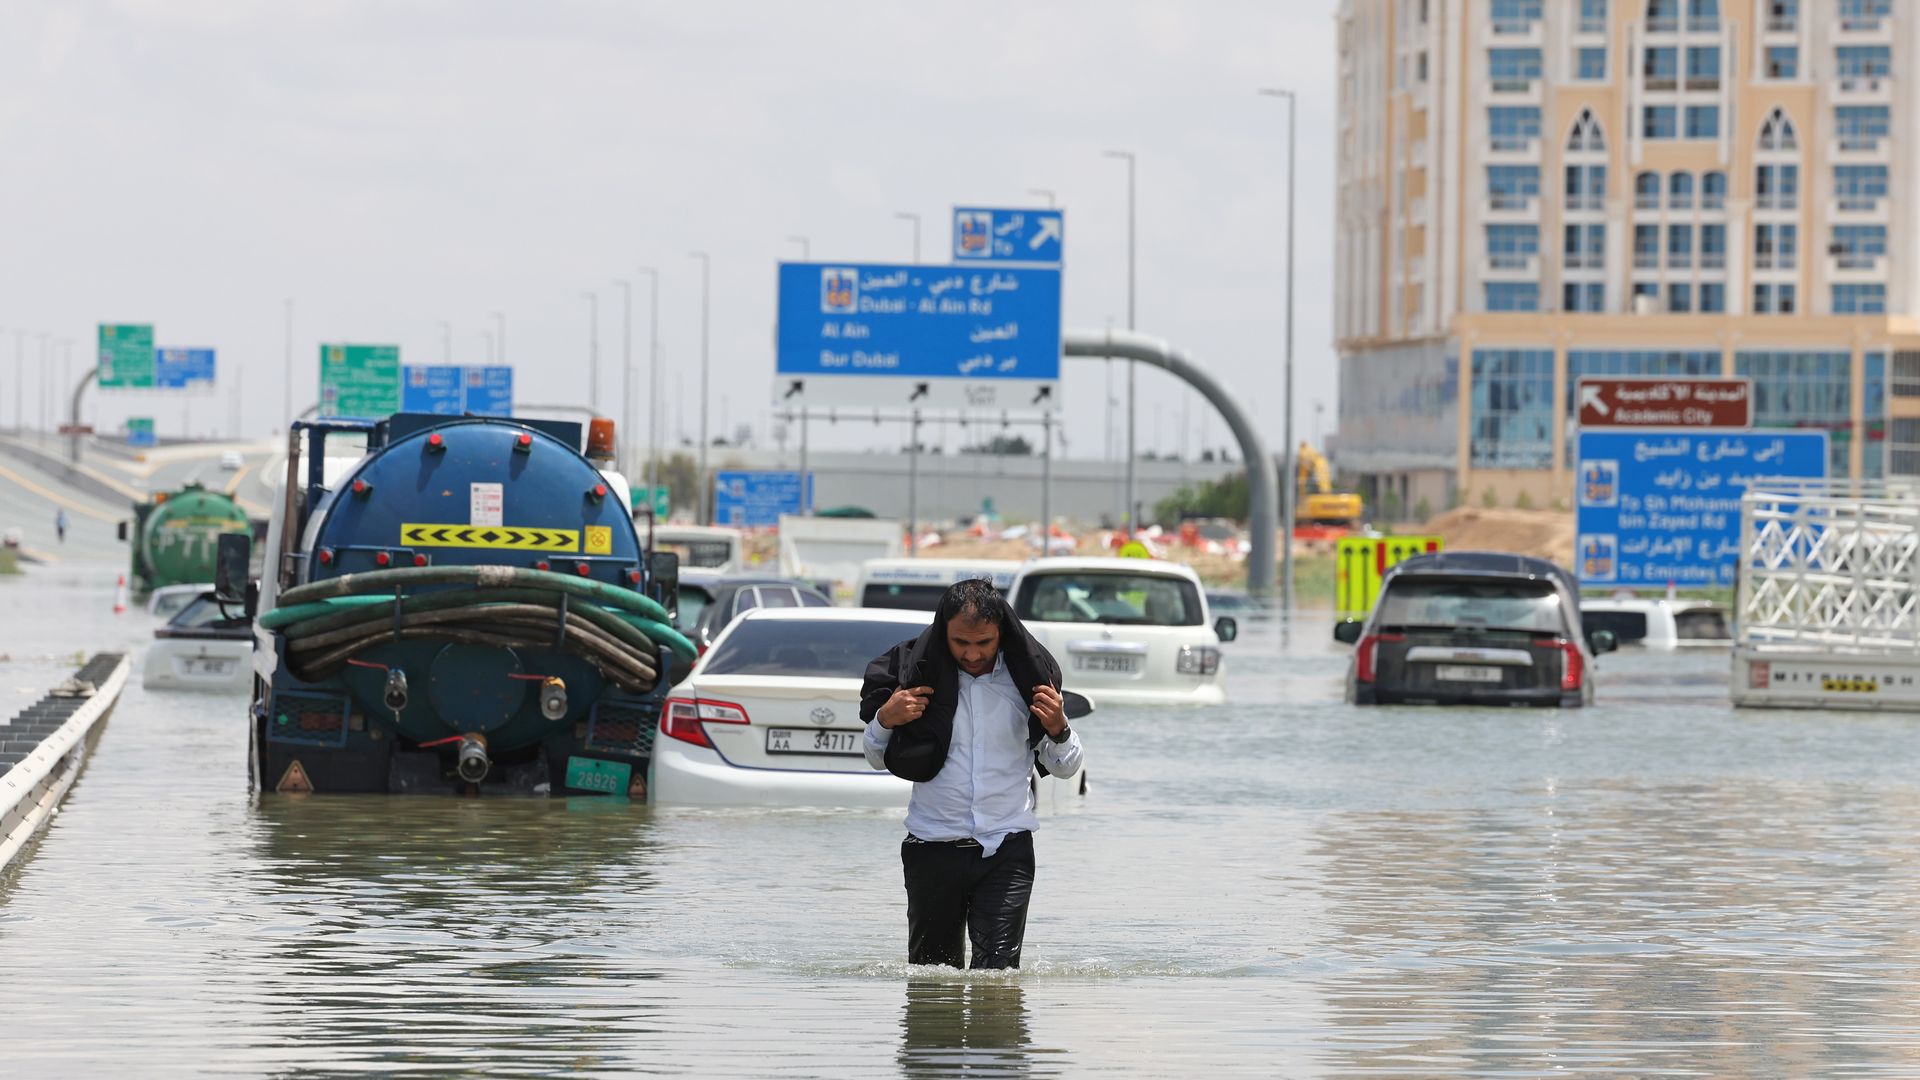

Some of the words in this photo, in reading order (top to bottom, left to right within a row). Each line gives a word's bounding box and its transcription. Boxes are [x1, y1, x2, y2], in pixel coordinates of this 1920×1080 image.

[994, 238, 1014, 256] To
[859, 271, 908, 290] العين
[929, 276, 964, 295] دبي
[970, 274, 1019, 295] شارع
[860, 298, 906, 315] Dubai
[917, 299, 937, 315] Al
[939, 300, 966, 316] Ain
[969, 300, 991, 316] Rd
[821, 322, 840, 339] Al
[842, 322, 870, 339] Ain
[969, 323, 1019, 344] العين
[820, 351, 848, 368] Bur
[852, 351, 900, 369] Dubai
[957, 354, 994, 375] دبي
[997, 355, 1019, 373] بر
[1694, 384, 1747, 403] المدينة
[1614, 406, 1680, 424] Academic
[1683, 407, 1714, 427] City
[1633, 439, 1691, 462] الشيخ
[1696, 439, 1748, 461] شارع
[1752, 439, 1786, 464] إلى
[1654, 467, 1693, 490] زايد
[1695, 472, 1722, 490] بن
[1620, 495, 1641, 511] To
[1645, 495, 1668, 511] Sh
[1671, 495, 1742, 512] Mohamm
[1618, 513, 1645, 529] bin
[1647, 513, 1699, 533] Zayed
[1701, 514, 1726, 530] Rd
[1621, 535, 1693, 562] الإمارات
[1619, 564, 1640, 580] To
[774, 739, 790, 751] AA
[814, 734, 856, 751] 34717
[576, 771, 618, 793] 28926
